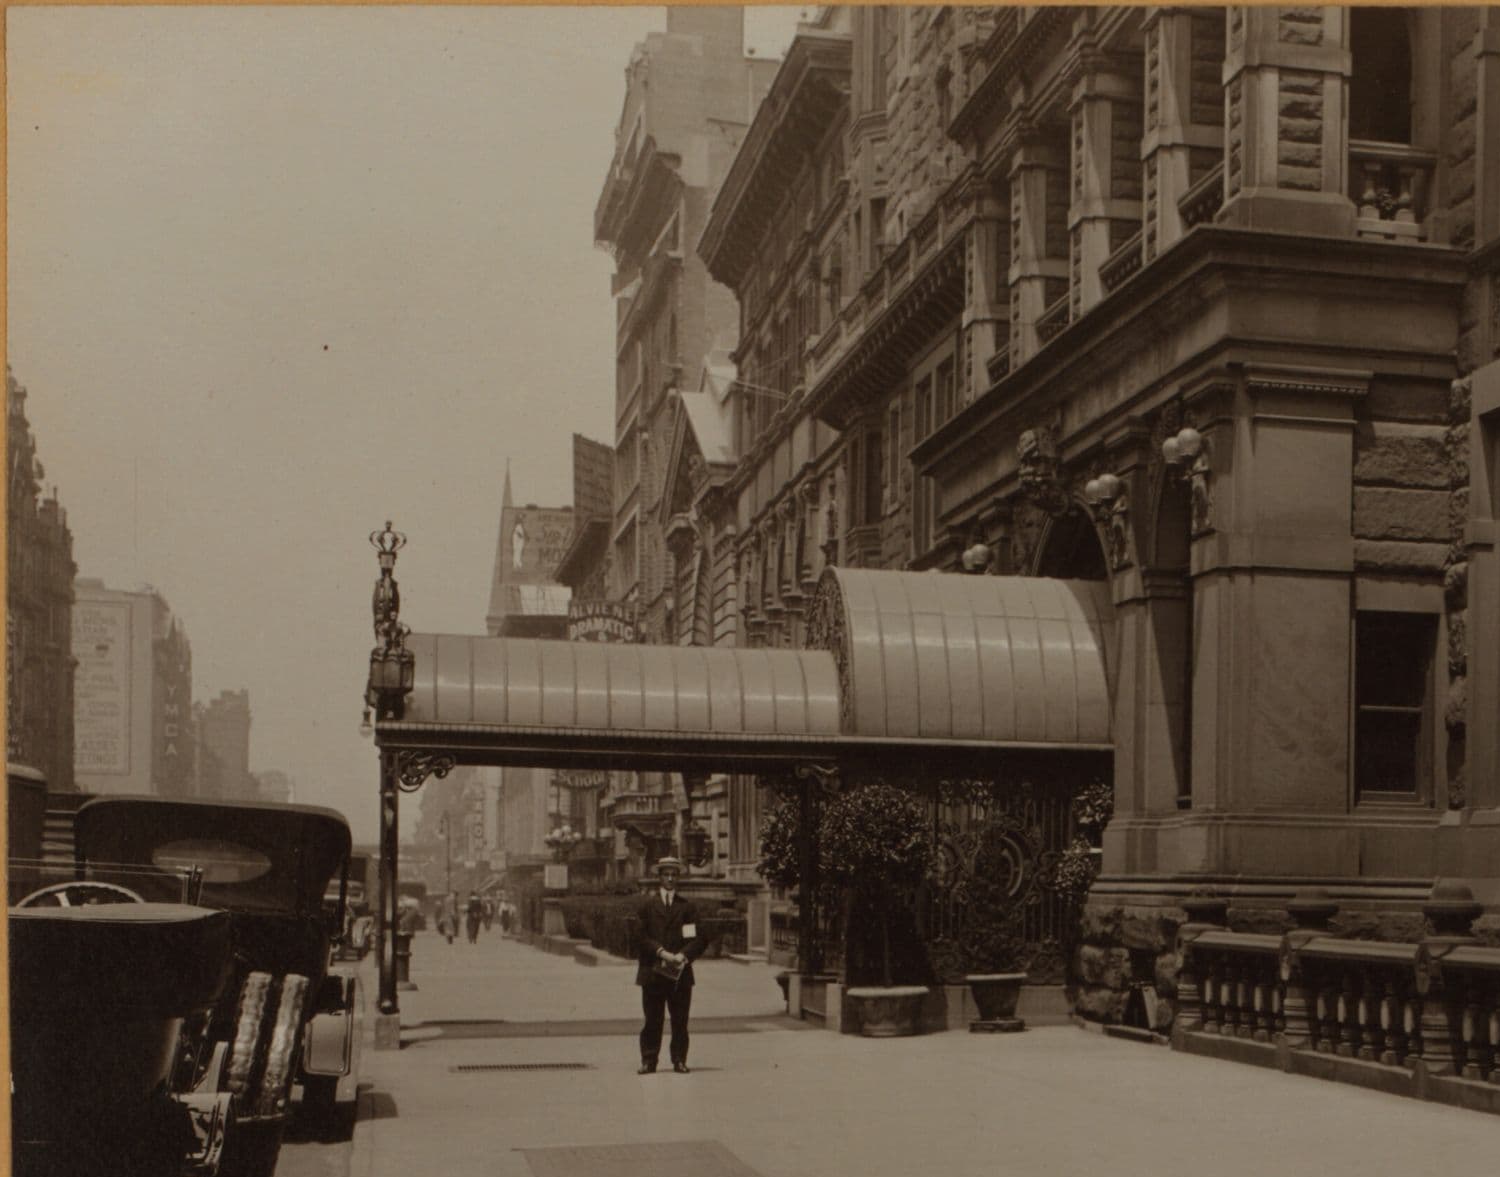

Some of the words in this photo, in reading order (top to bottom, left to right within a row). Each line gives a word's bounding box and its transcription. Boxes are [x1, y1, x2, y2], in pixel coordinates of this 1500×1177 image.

[570, 602, 634, 622] ALVIENE
[569, 617, 634, 641] DRAMATIC
[164, 684, 179, 756] YMCA
